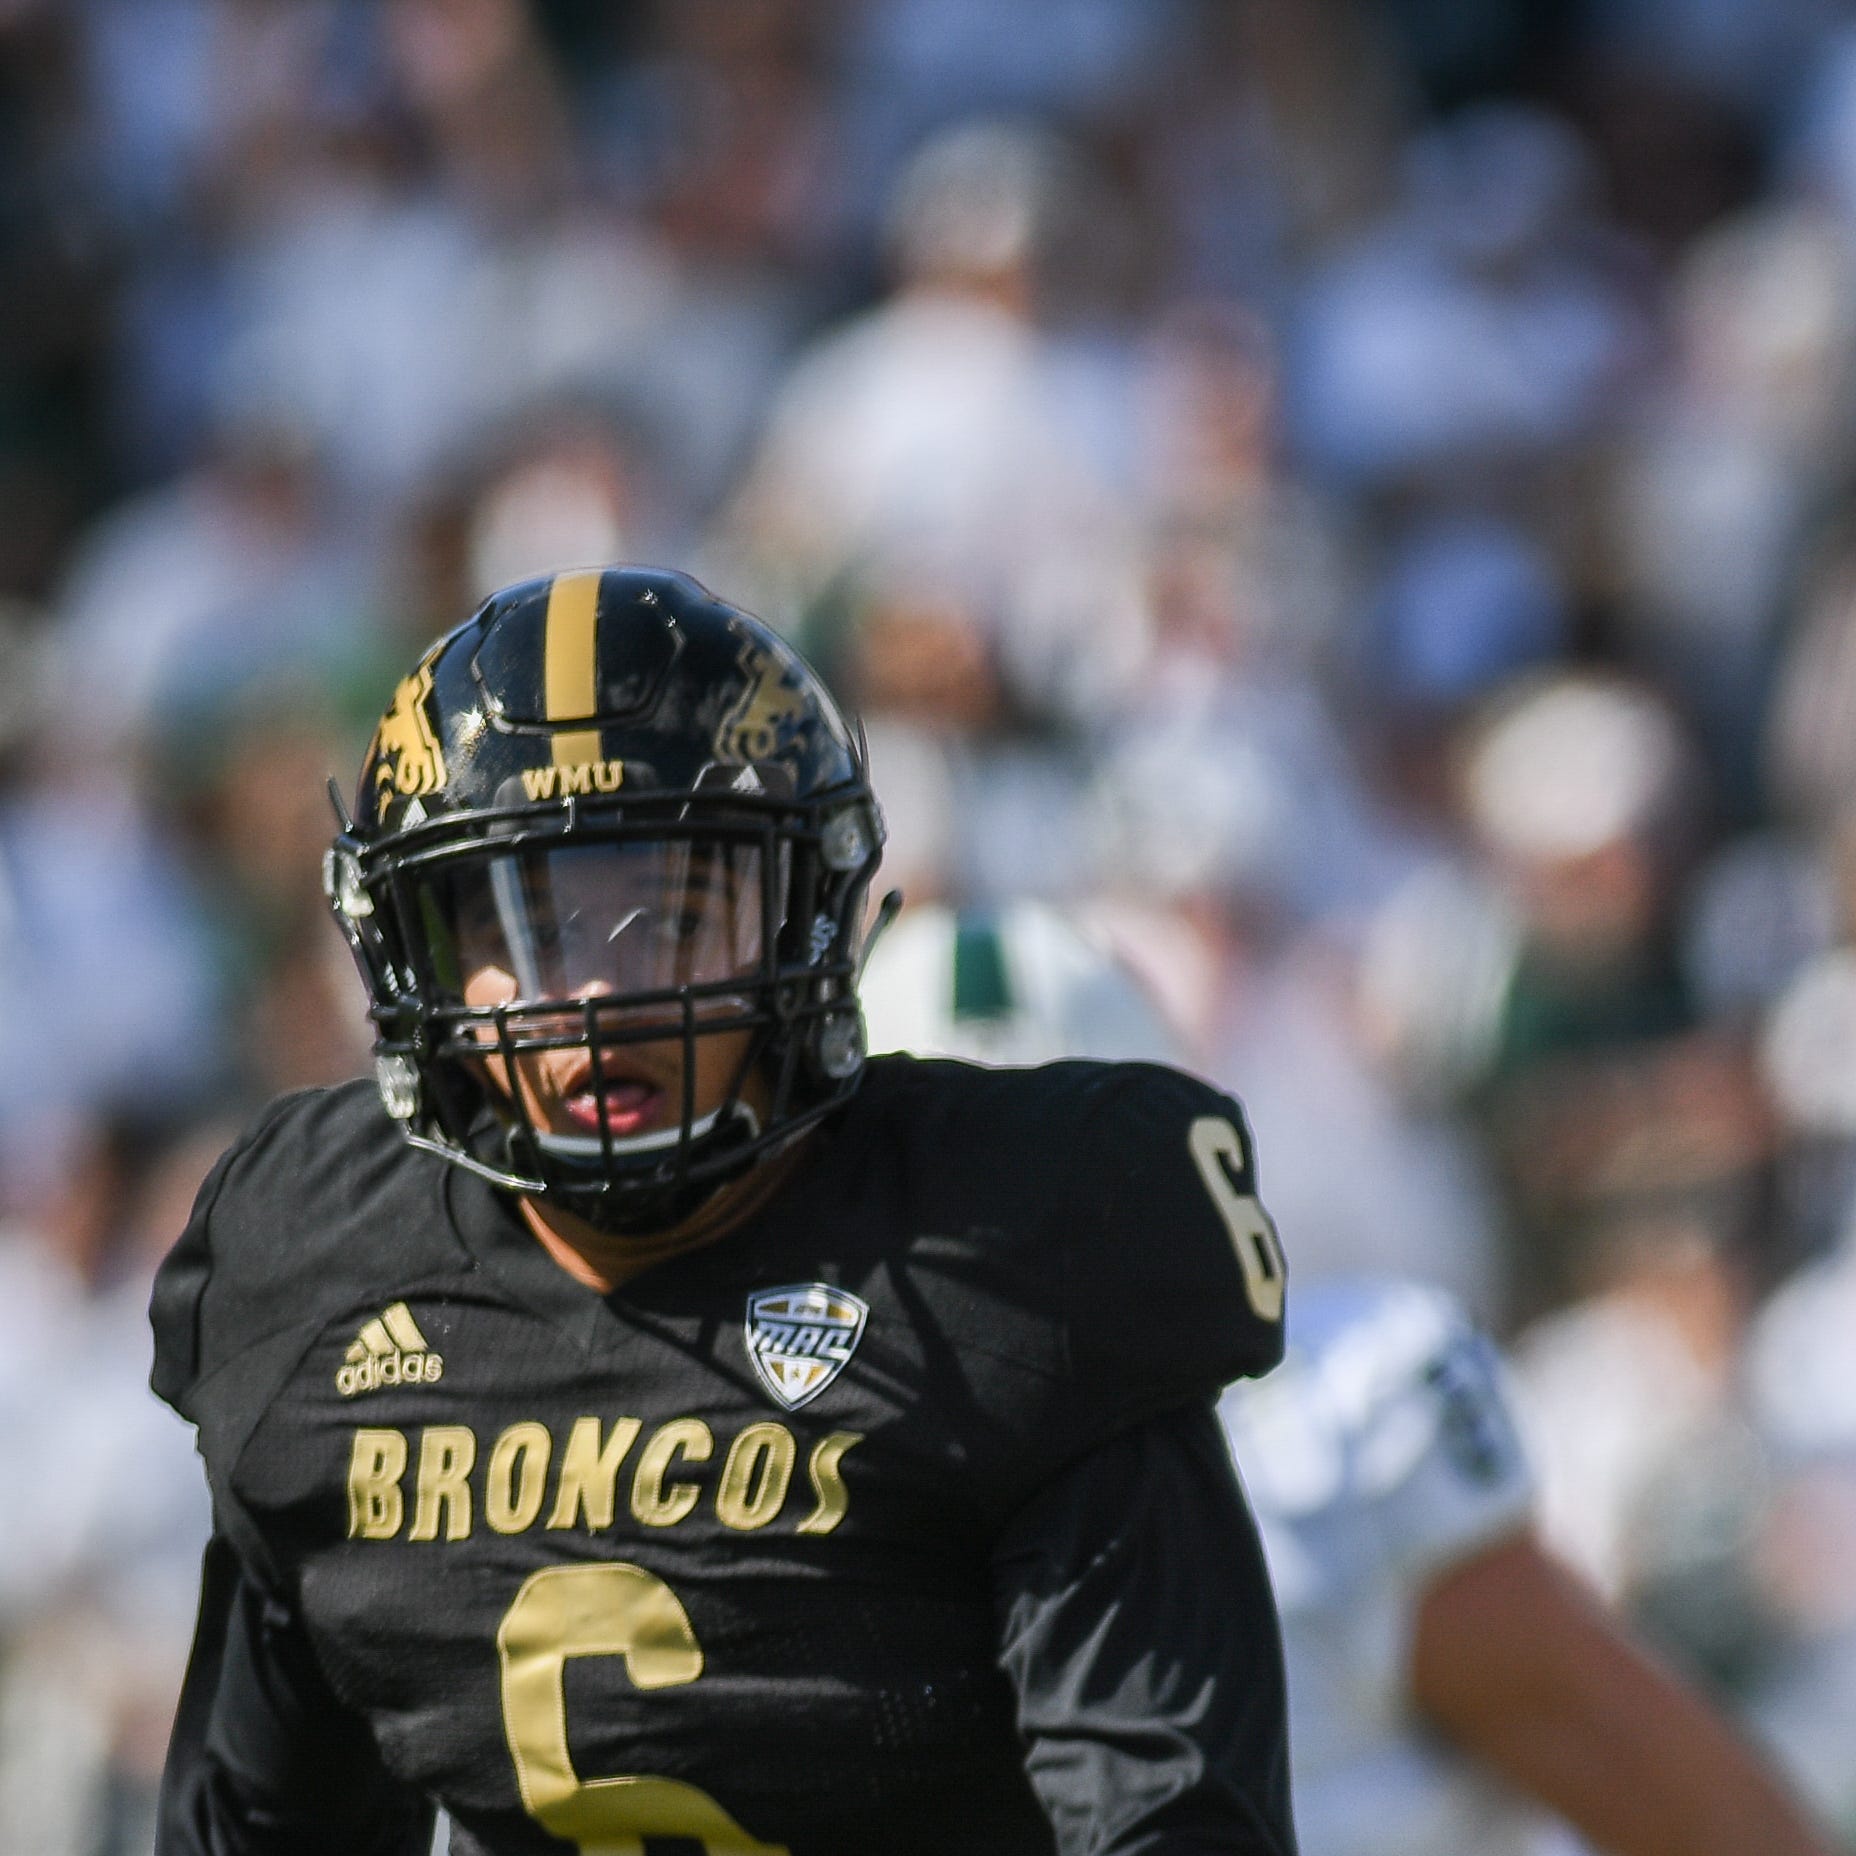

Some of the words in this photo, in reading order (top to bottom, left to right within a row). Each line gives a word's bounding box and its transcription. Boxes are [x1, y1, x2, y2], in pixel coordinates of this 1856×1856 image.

[521, 759, 624, 802] WMU
[335, 1346, 444, 1397] adidas
[347, 1415, 866, 1543] BRONCOS
